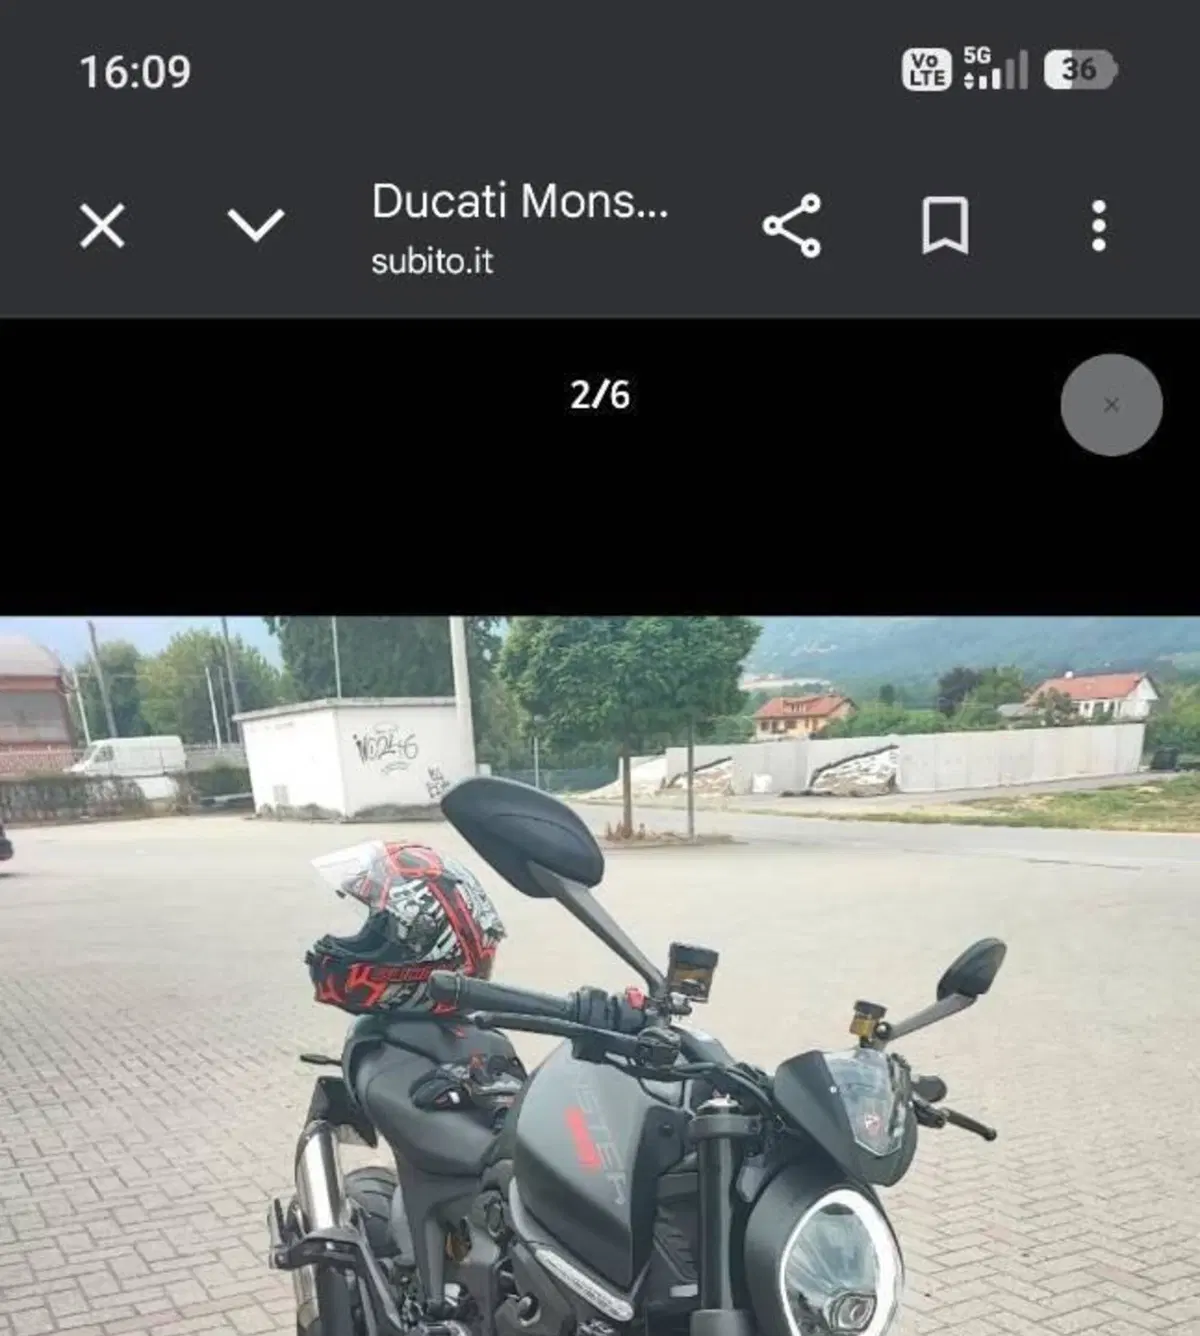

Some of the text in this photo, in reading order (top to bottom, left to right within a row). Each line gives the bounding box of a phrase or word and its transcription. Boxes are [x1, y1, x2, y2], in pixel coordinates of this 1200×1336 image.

[911, 53, 938, 68] Vo
[963, 45, 992, 65] 5G
[80, 54, 191, 90] 16:09
[910, 69, 945, 86] LTE
[1061, 57, 1097, 81] 36
[373, 179, 668, 219] Ducati Mons...
[371, 245, 494, 275] subito.it
[571, 378, 630, 409] 2/6
